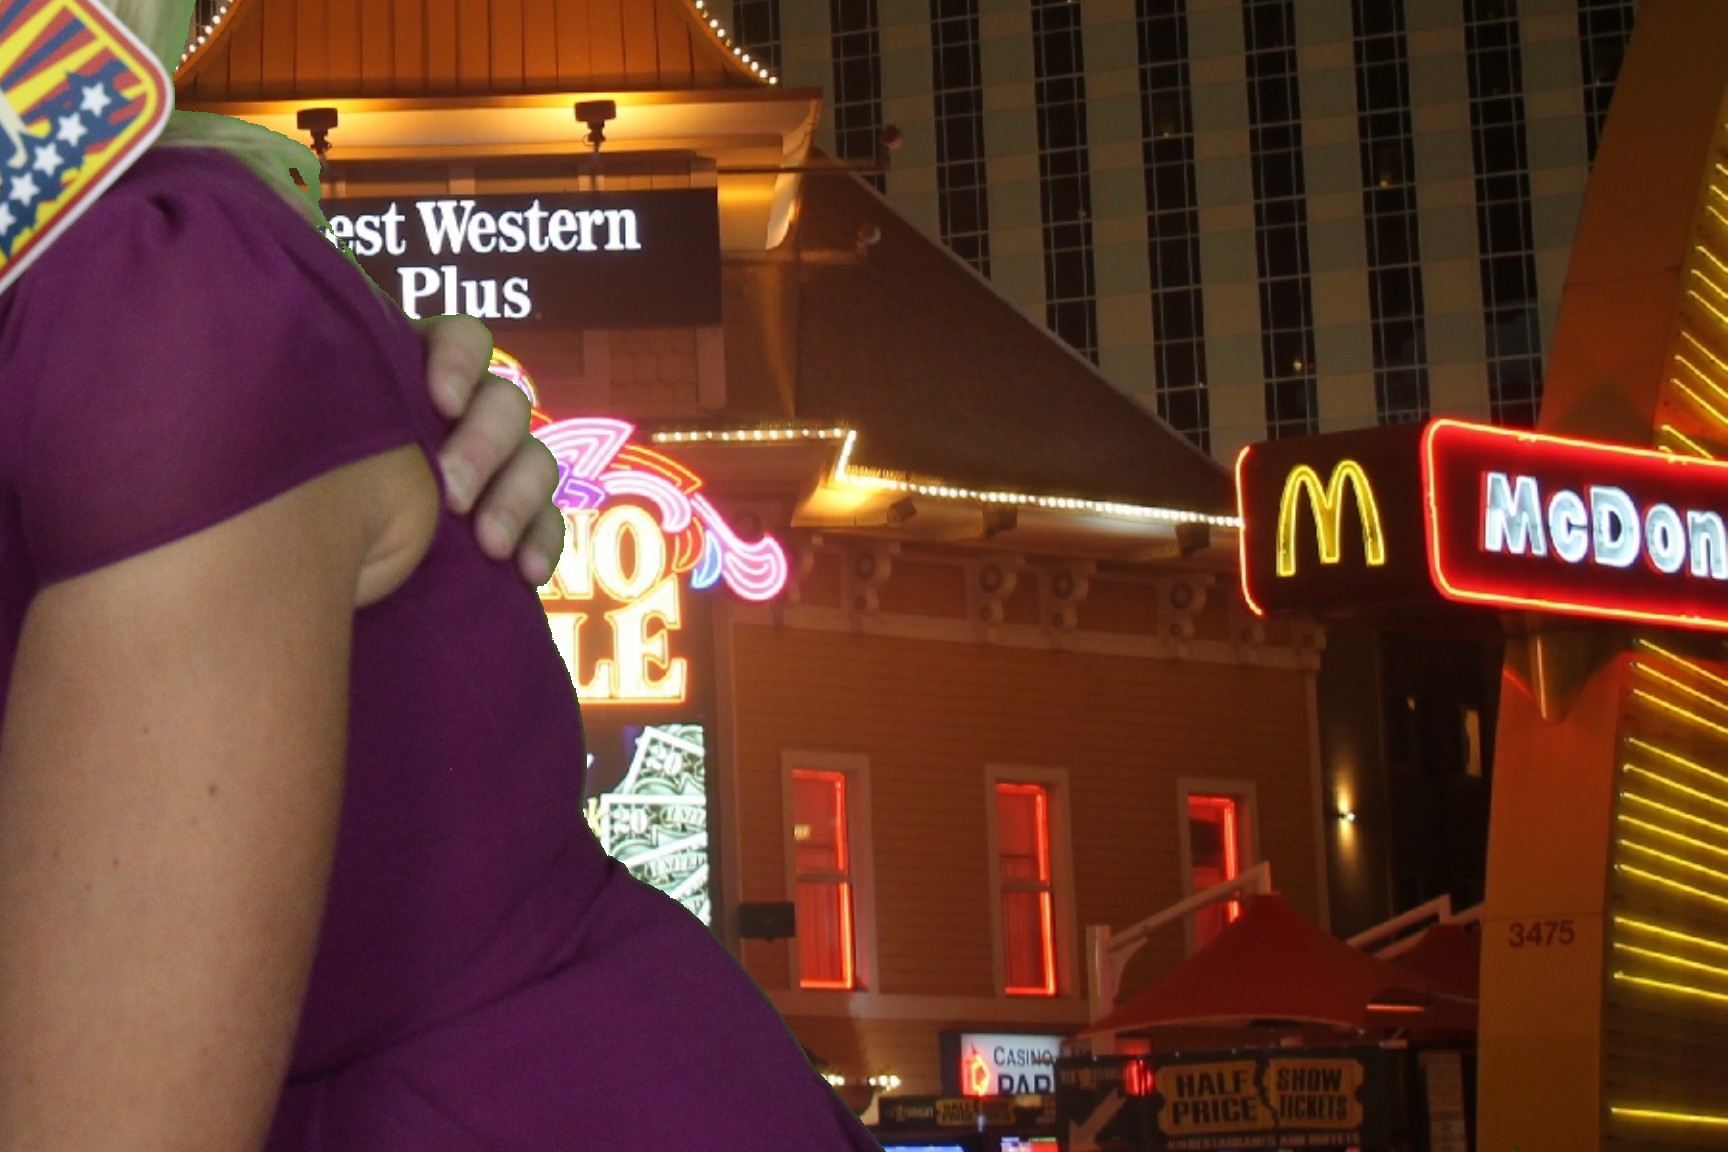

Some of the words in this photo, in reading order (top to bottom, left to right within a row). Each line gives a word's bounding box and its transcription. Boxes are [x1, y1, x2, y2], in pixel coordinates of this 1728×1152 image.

[324, 201, 408, 256] est
[415, 198, 642, 255] Western
[396, 264, 533, 320] Plus
[1482, 471, 1727, 581] McDon
[1508, 919, 1576, 948] 3475
[1175, 1070, 1249, 1098] HALF
[1276, 1067, 1343, 1093] SHOW
[1172, 1098, 1258, 1125] PRICE
[1279, 1094, 1348, 1121] TICKETS
